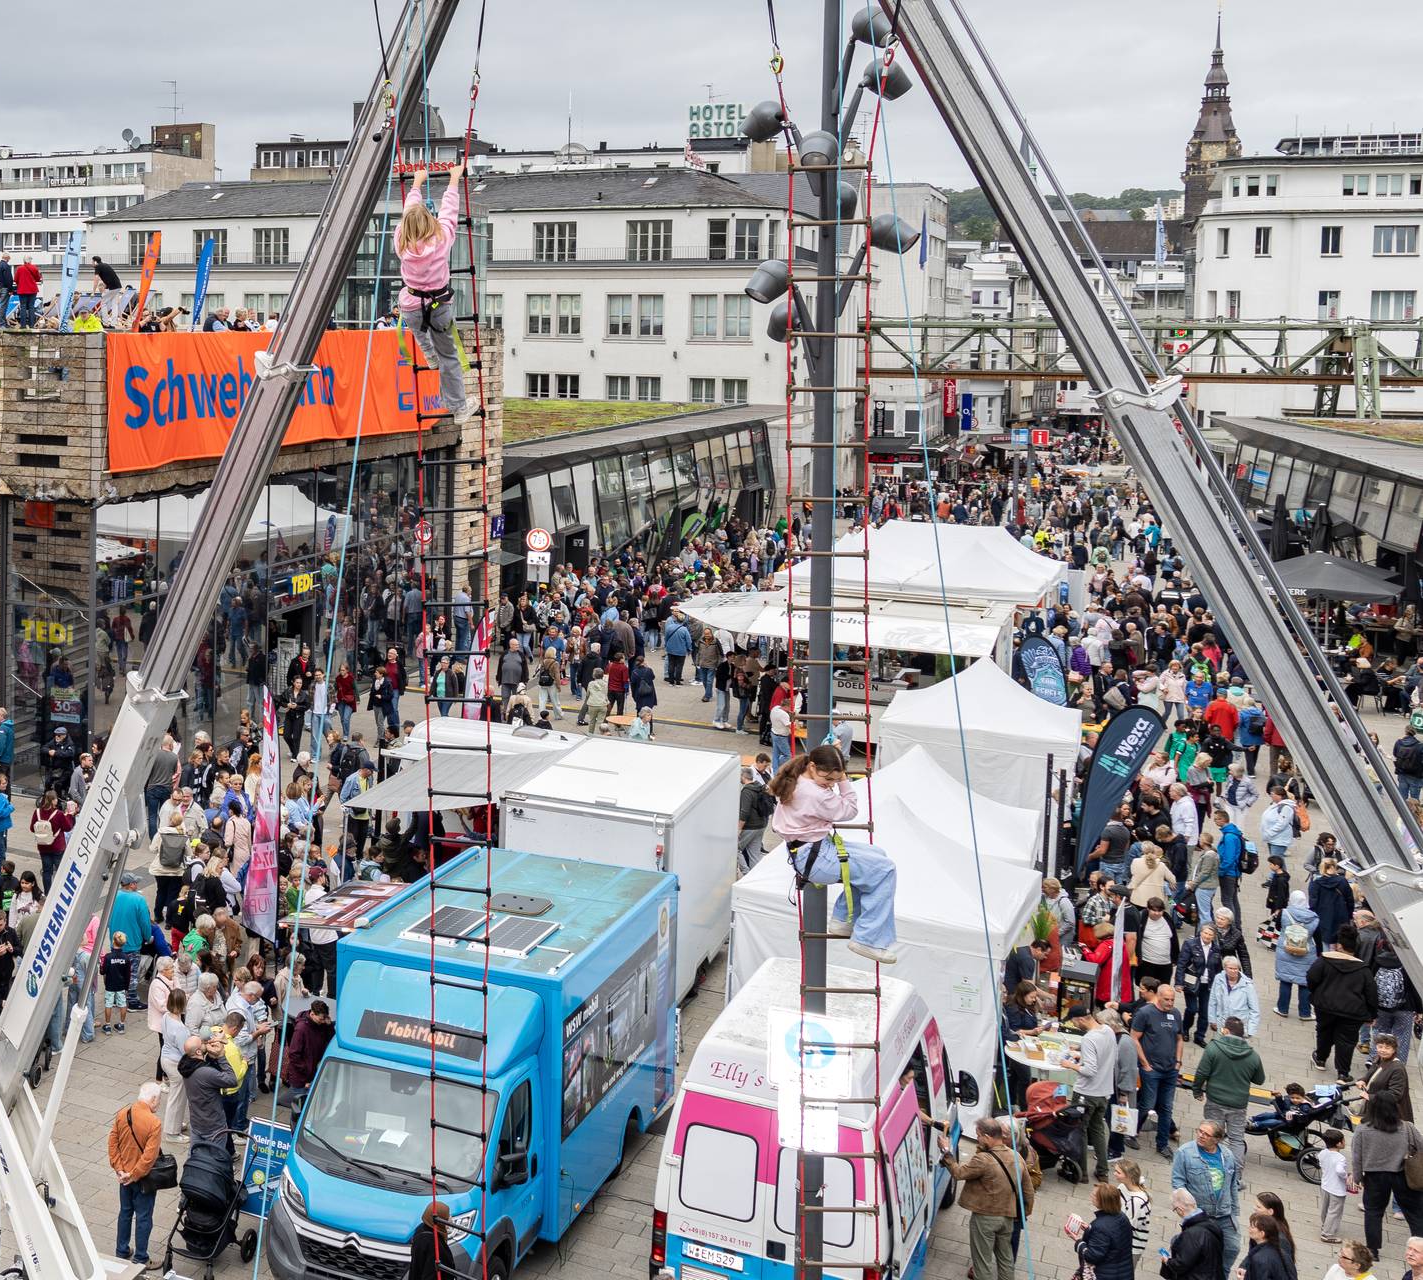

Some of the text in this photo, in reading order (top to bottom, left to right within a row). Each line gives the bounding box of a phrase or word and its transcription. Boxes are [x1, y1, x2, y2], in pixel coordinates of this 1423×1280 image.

[689, 104, 747, 121] HOTEL
[291, 572, 314, 595] TEDi
[21, 618, 74, 646] TEDi
[1115, 717, 1151, 758] Wera
[32, 764, 121, 979] SYSTEM LIFT SPIELHOFF
[384, 1020, 456, 1049] MobiMobil
[565, 1010, 582, 1038] WSW
[253, 1133, 276, 1148] Kleine
[720, 1234, 728, 1242] 33
[729, 1236, 737, 1244] 47
[716, 1253, 735, 1267] 529
